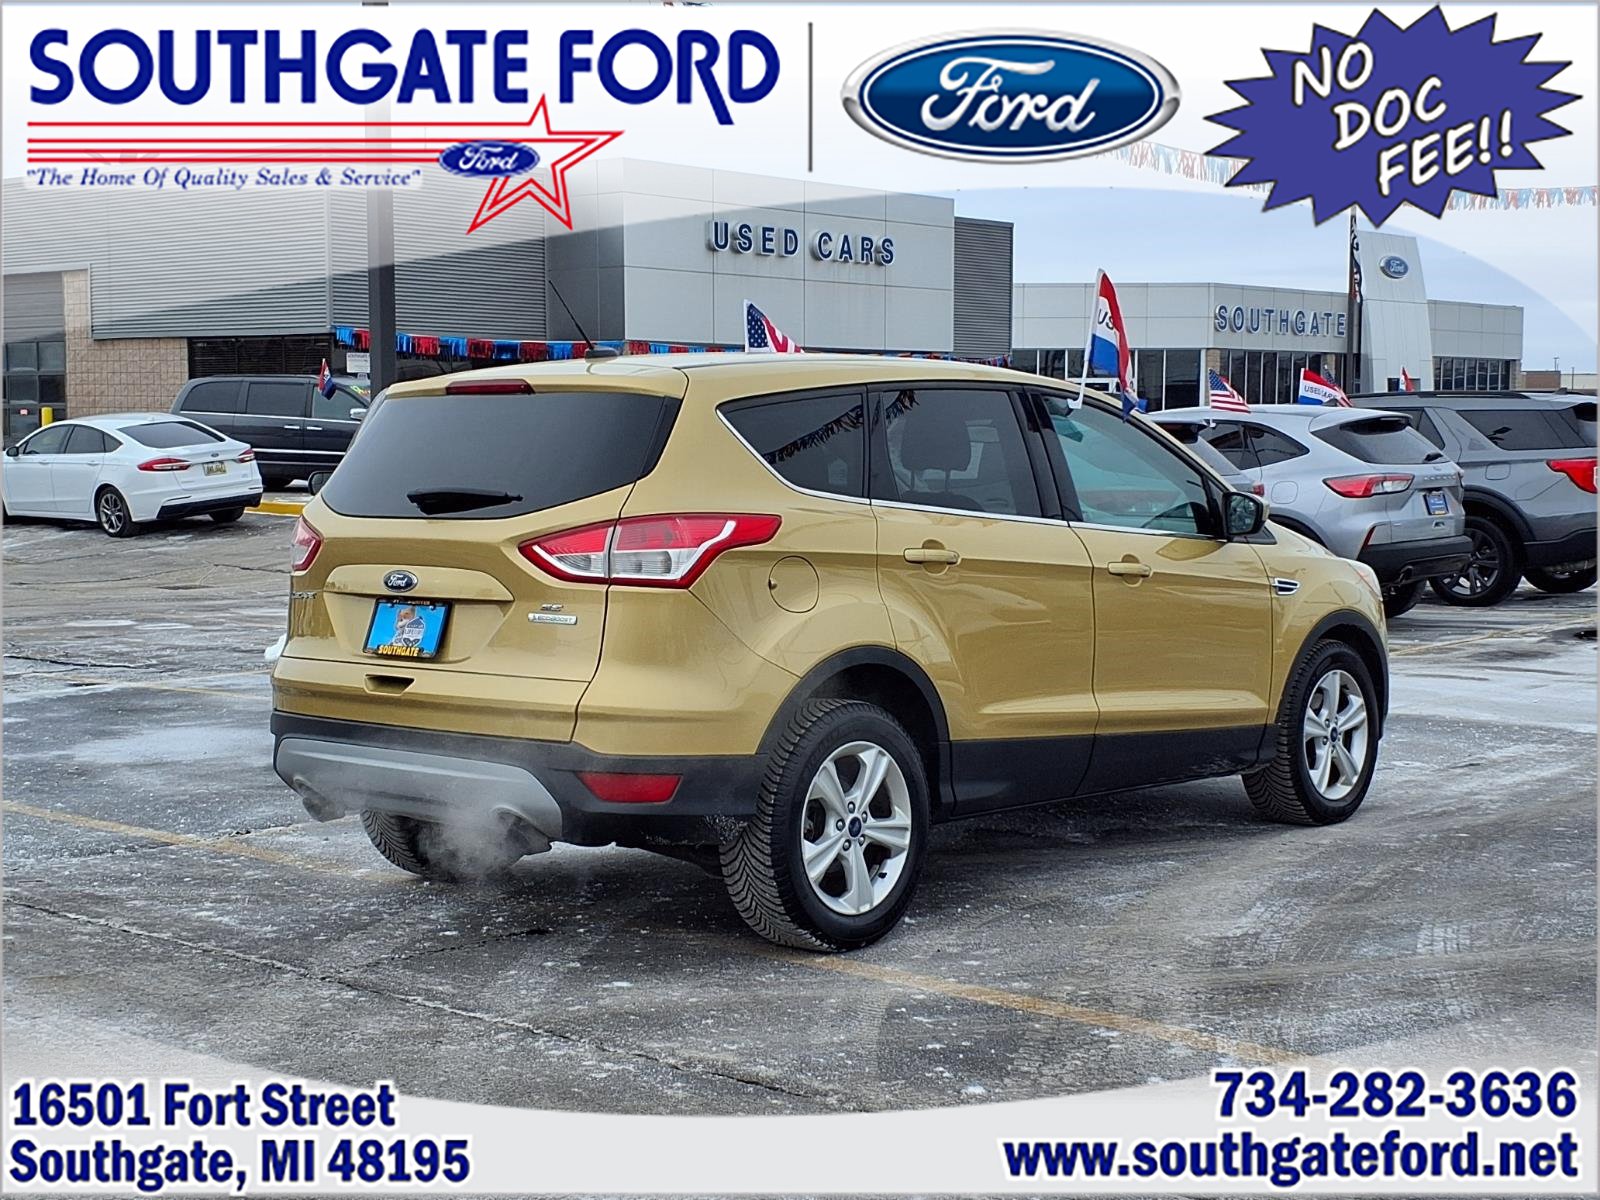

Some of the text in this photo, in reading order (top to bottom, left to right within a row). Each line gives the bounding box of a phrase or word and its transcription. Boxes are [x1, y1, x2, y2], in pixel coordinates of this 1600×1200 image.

[710, 220, 895, 266] USED CARS
[1215, 304, 1346, 337] SOUTHGATE
[387, 574, 408, 587] Ford
[378, 644, 421, 658] SOUTHGATE
